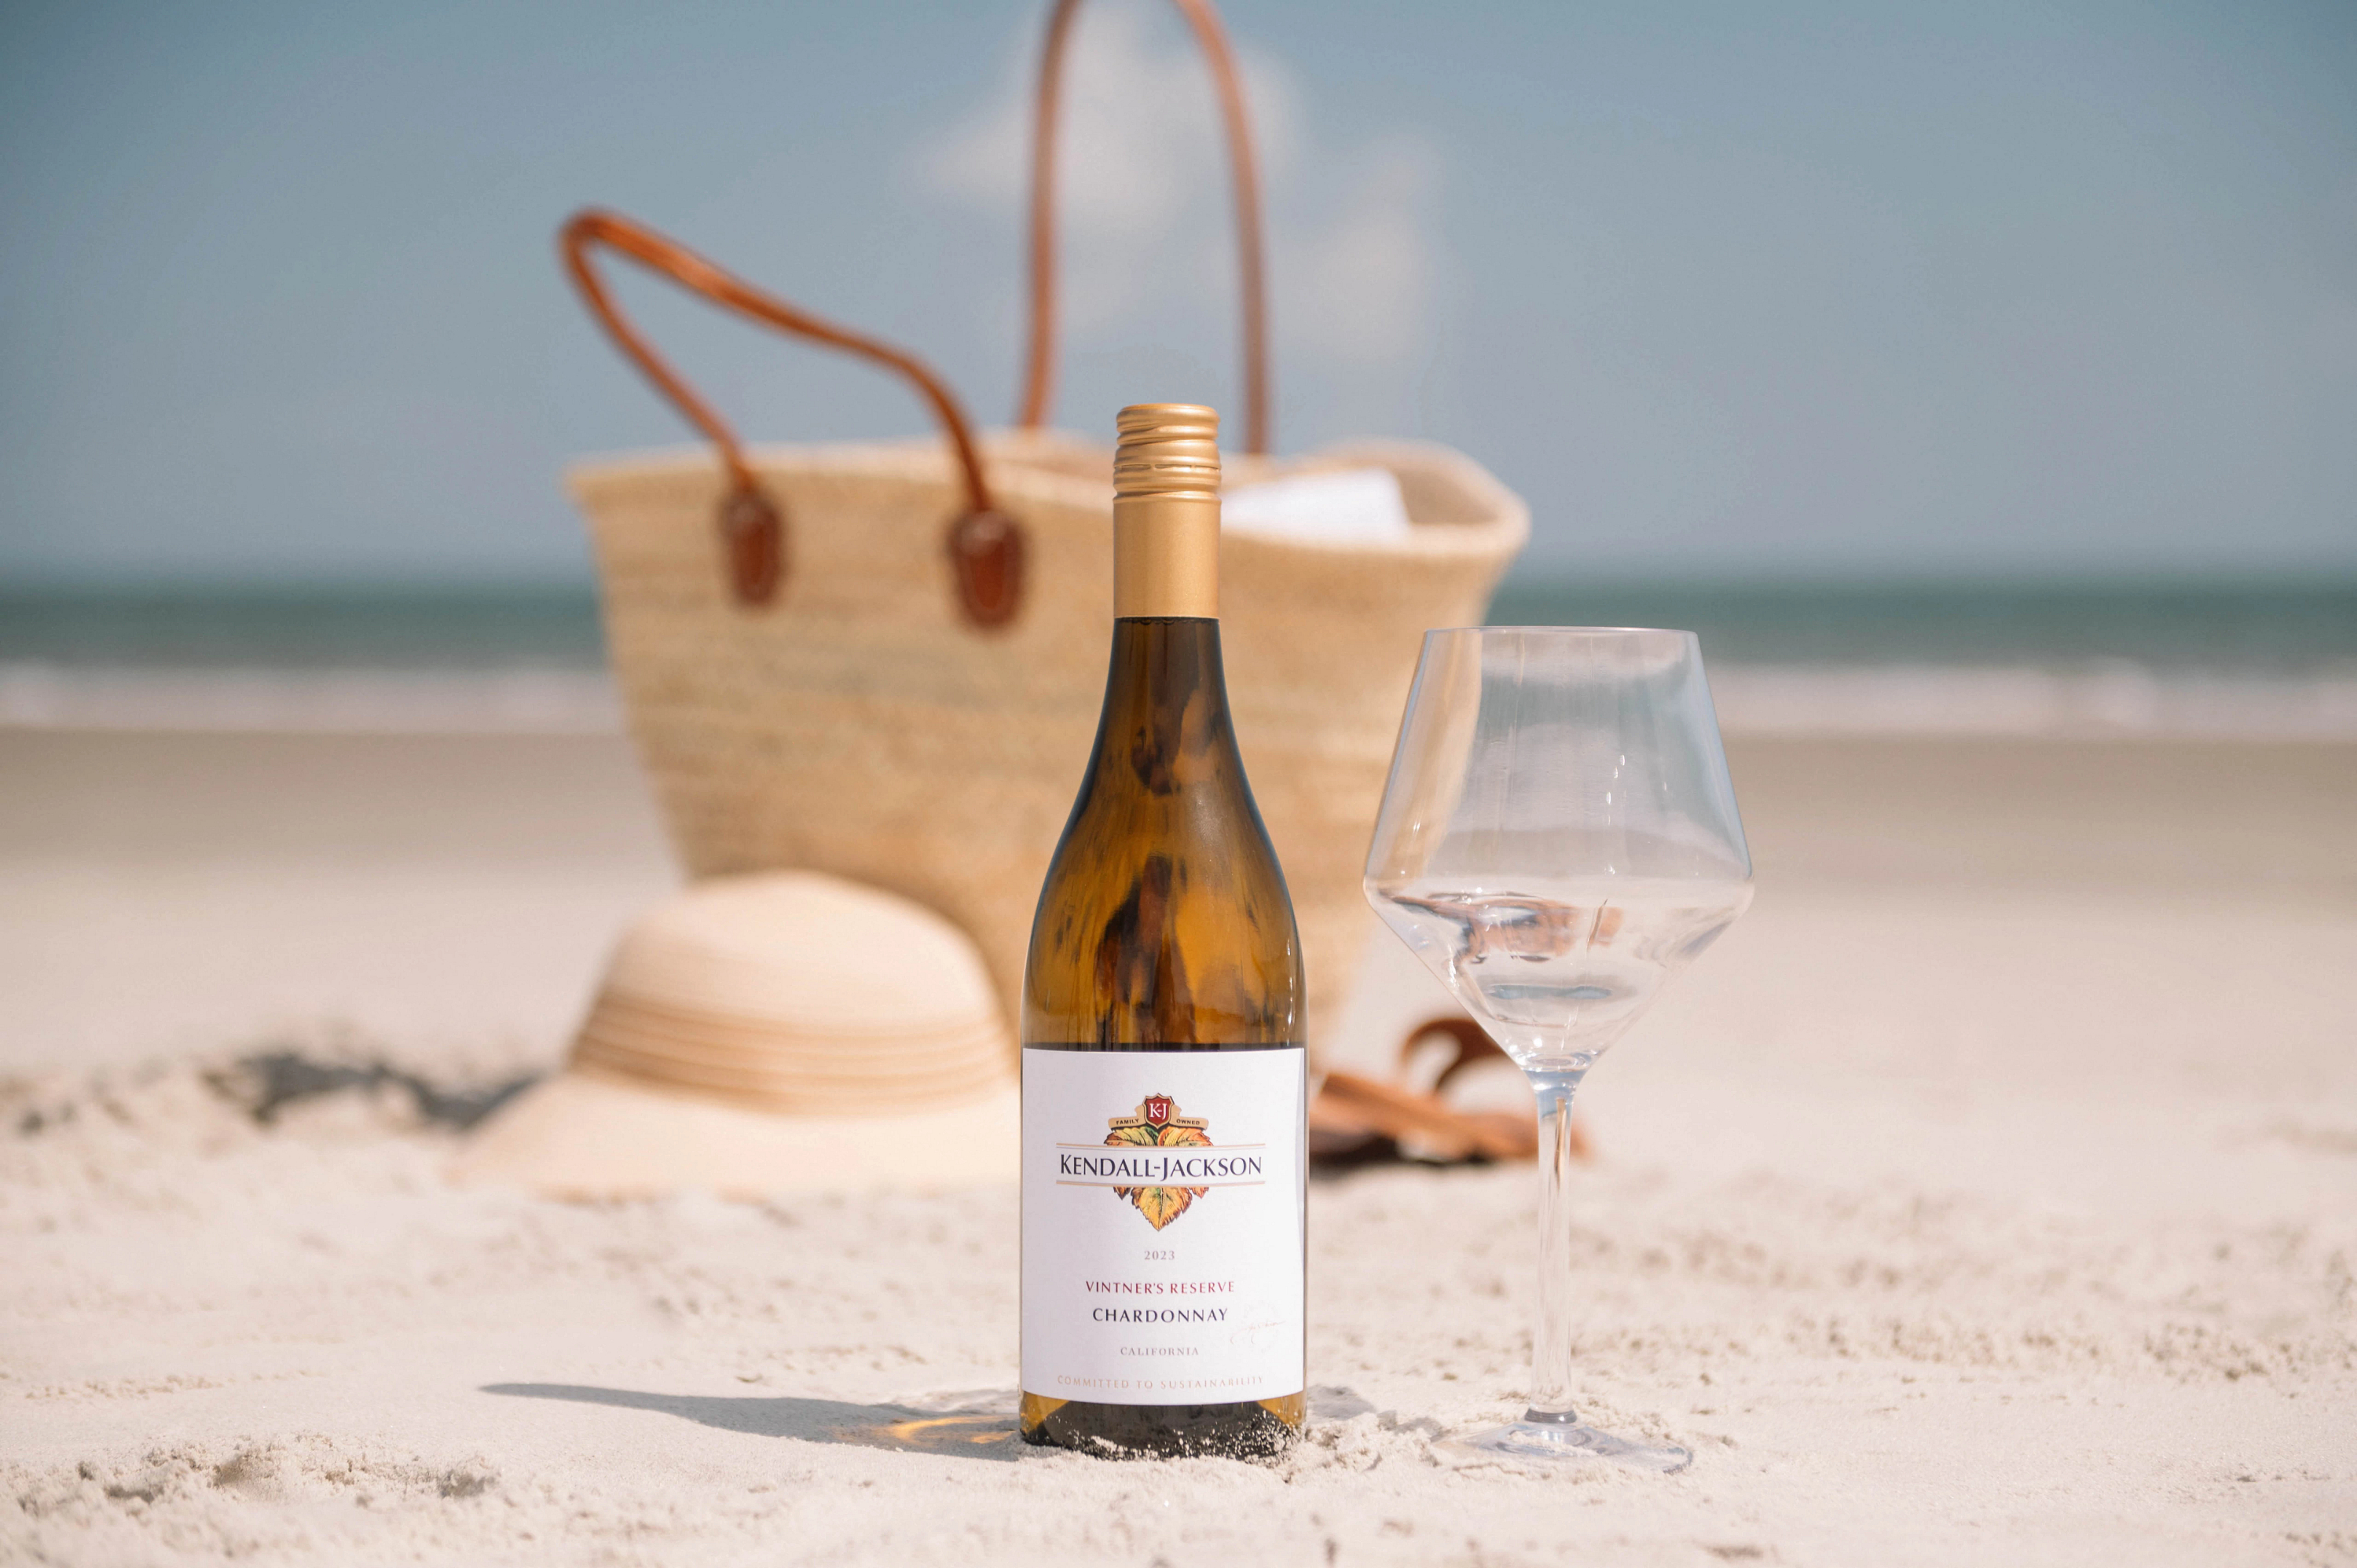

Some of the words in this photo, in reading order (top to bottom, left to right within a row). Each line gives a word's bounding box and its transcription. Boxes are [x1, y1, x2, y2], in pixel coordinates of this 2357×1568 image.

[1149, 1103, 1168, 1120] K-J
[1060, 1154, 1263, 1181] KENDALL-JACKSON
[1144, 1251, 1175, 1260] 2023
[1085, 1280, 1164, 1295] VINTNER'S
[1170, 1281, 1234, 1295] RESERVE
[1092, 1307, 1228, 1323] CHARDONNAY
[1120, 1346, 1199, 1356] CALIFORNIA
[1058, 1375, 1129, 1389] COMMITTED
[1137, 1380, 1153, 1389] TO
[1160, 1376, 1263, 1389] SUSTAINABILITY
